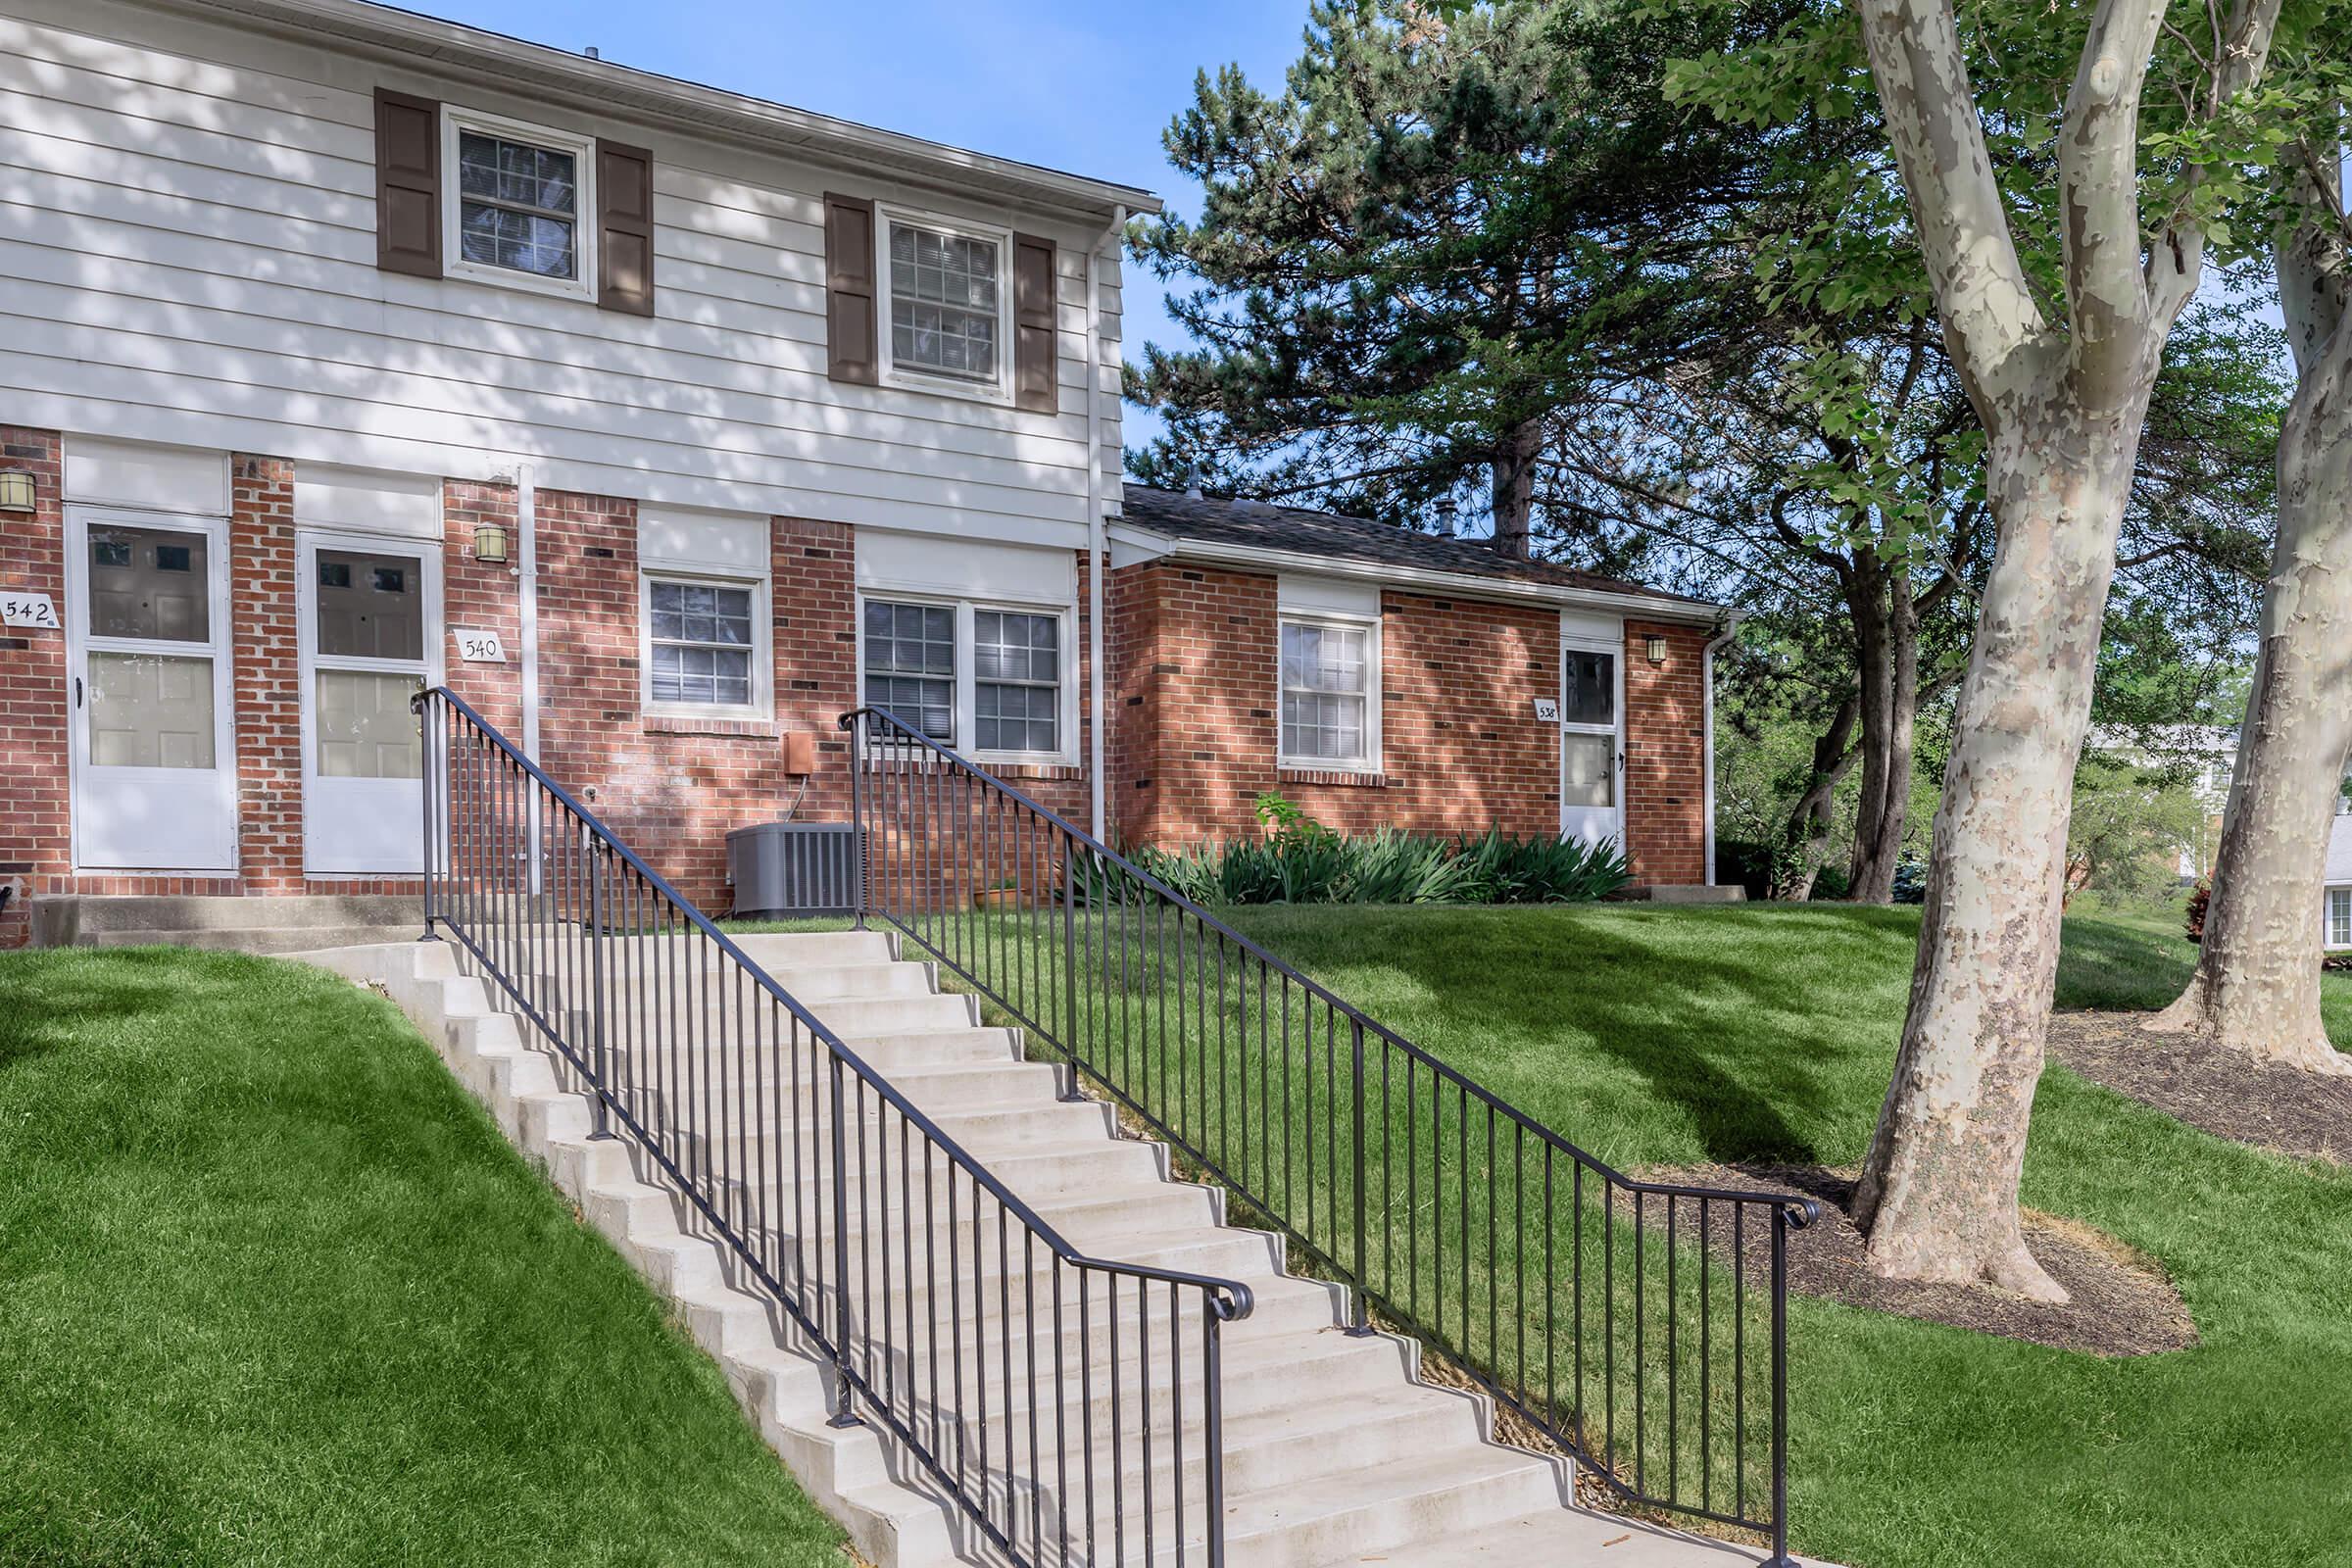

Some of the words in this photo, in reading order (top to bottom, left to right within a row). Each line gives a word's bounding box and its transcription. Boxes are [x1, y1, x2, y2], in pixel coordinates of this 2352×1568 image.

[6, 601, 49, 621] 542
[466, 640, 496, 658] 540
[1540, 707, 1555, 718] 538
